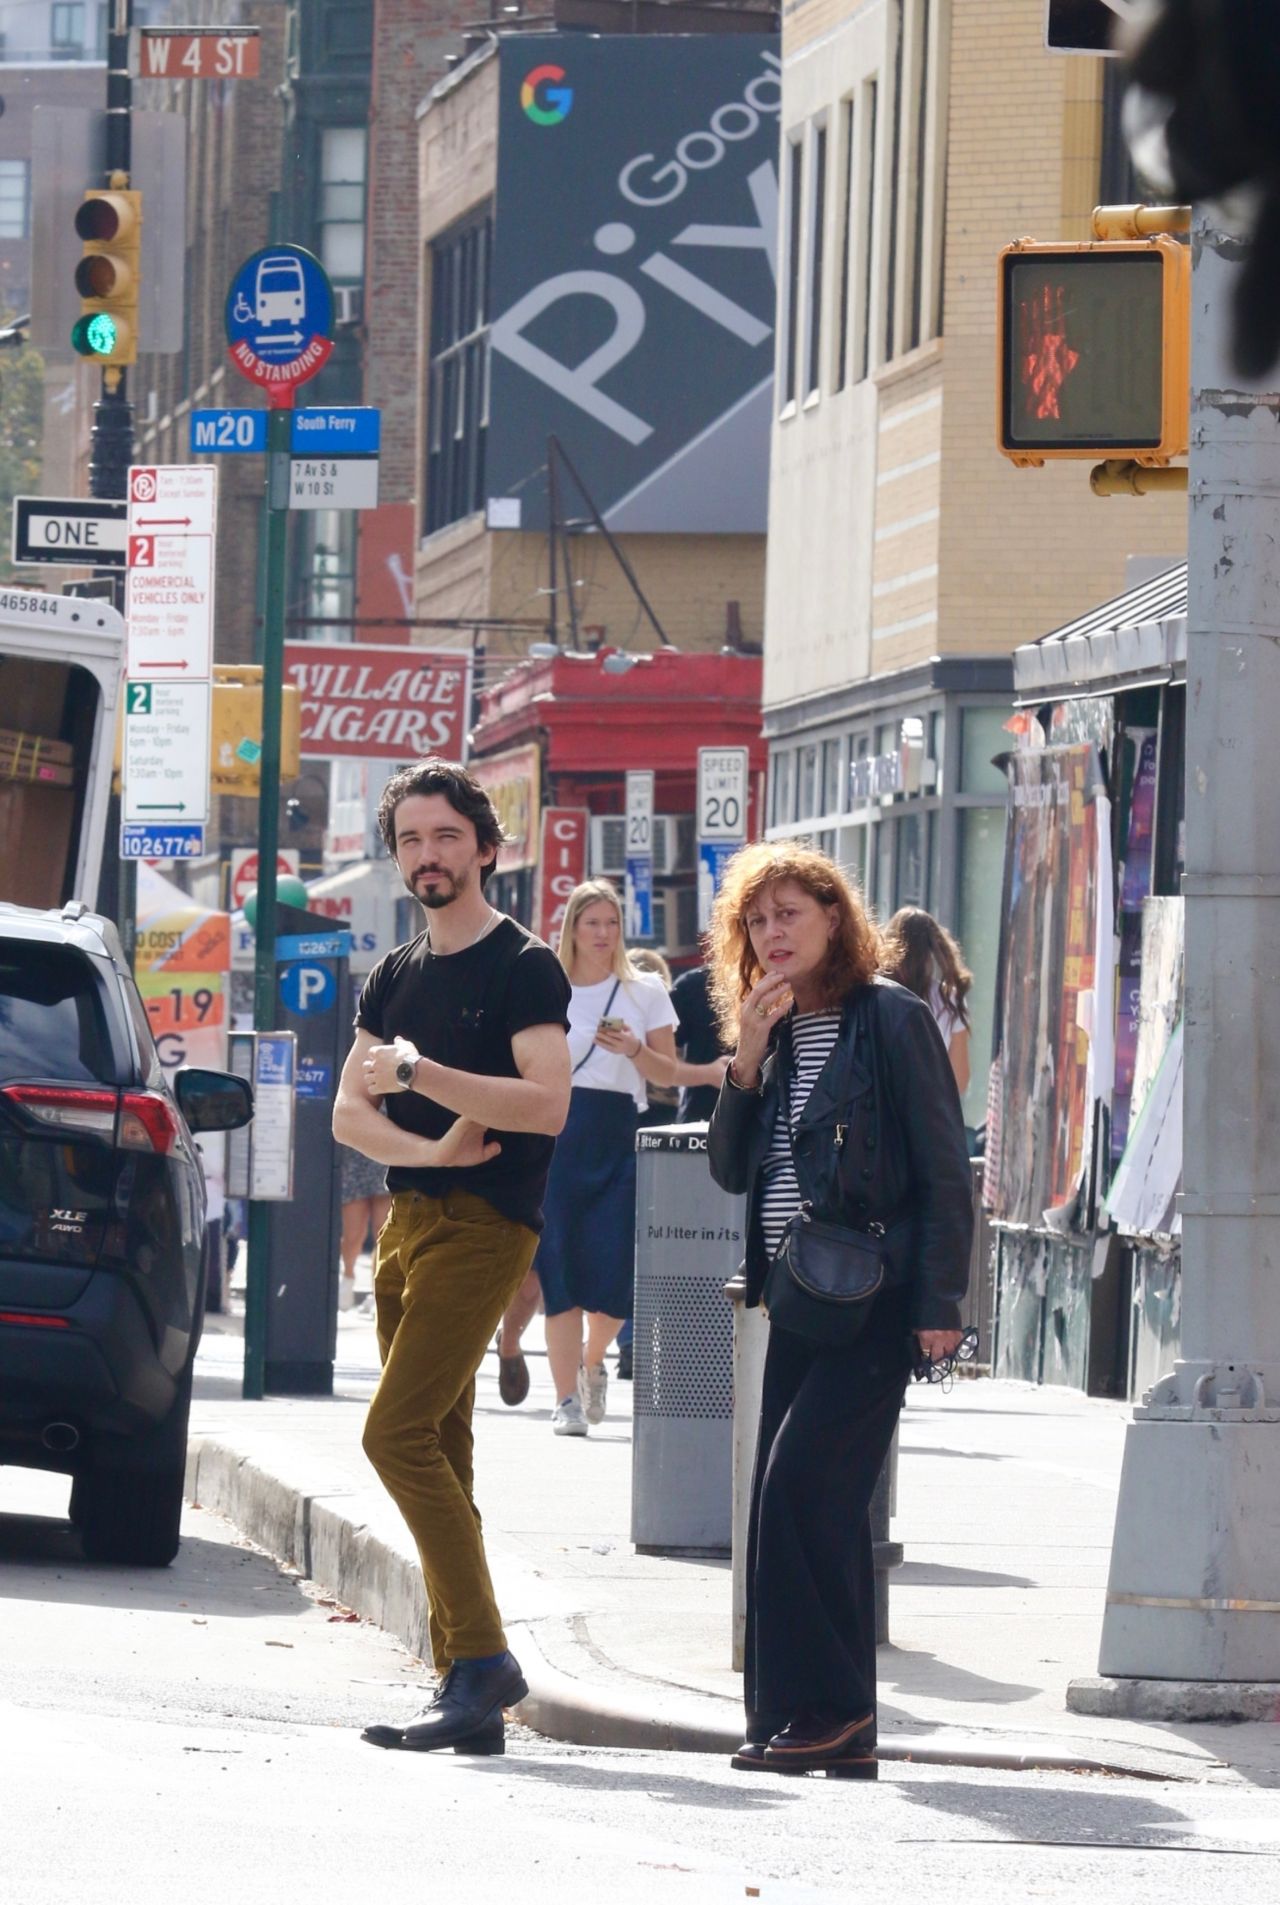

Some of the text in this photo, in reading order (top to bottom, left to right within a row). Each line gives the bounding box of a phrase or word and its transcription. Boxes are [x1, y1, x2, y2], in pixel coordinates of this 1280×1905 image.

[147, 37, 249, 75] W 4 ST
[520, 64, 574, 126] G
[619, 50, 781, 207] Goog
[235, 340, 324, 382] NO STANDING
[195, 415, 255, 447] M20
[296, 415, 356, 433] South Ferry
[295, 463, 301, 477] 7
[304, 463, 317, 477] Av
[320, 463, 327, 477] S
[294, 482, 334, 495] W 10 St
[45, 520, 99, 546] ONE
[135, 538, 149, 566] 2
[132, 576, 195, 588] COMMERCIAL
[132, 592, 206, 604] VEHICLES ONLY
[288, 663, 462, 704] VILLAGE
[132, 685, 147, 713] 2
[166, 723, 190, 736] Friday
[300, 702, 457, 754] CIGARS
[704, 757, 742, 772] SPEED
[706, 776, 739, 791] LIMIT
[705, 796, 740, 828] 20
[630, 815, 649, 844] 20
[150, 931, 183, 948] COST
[299, 968, 326, 1010] P
[50, 1209, 88, 1222] XLE
[51, 1223, 83, 1233] AWD
[701, 1227, 715, 1241] in
[718, 1227, 740, 1241] its
